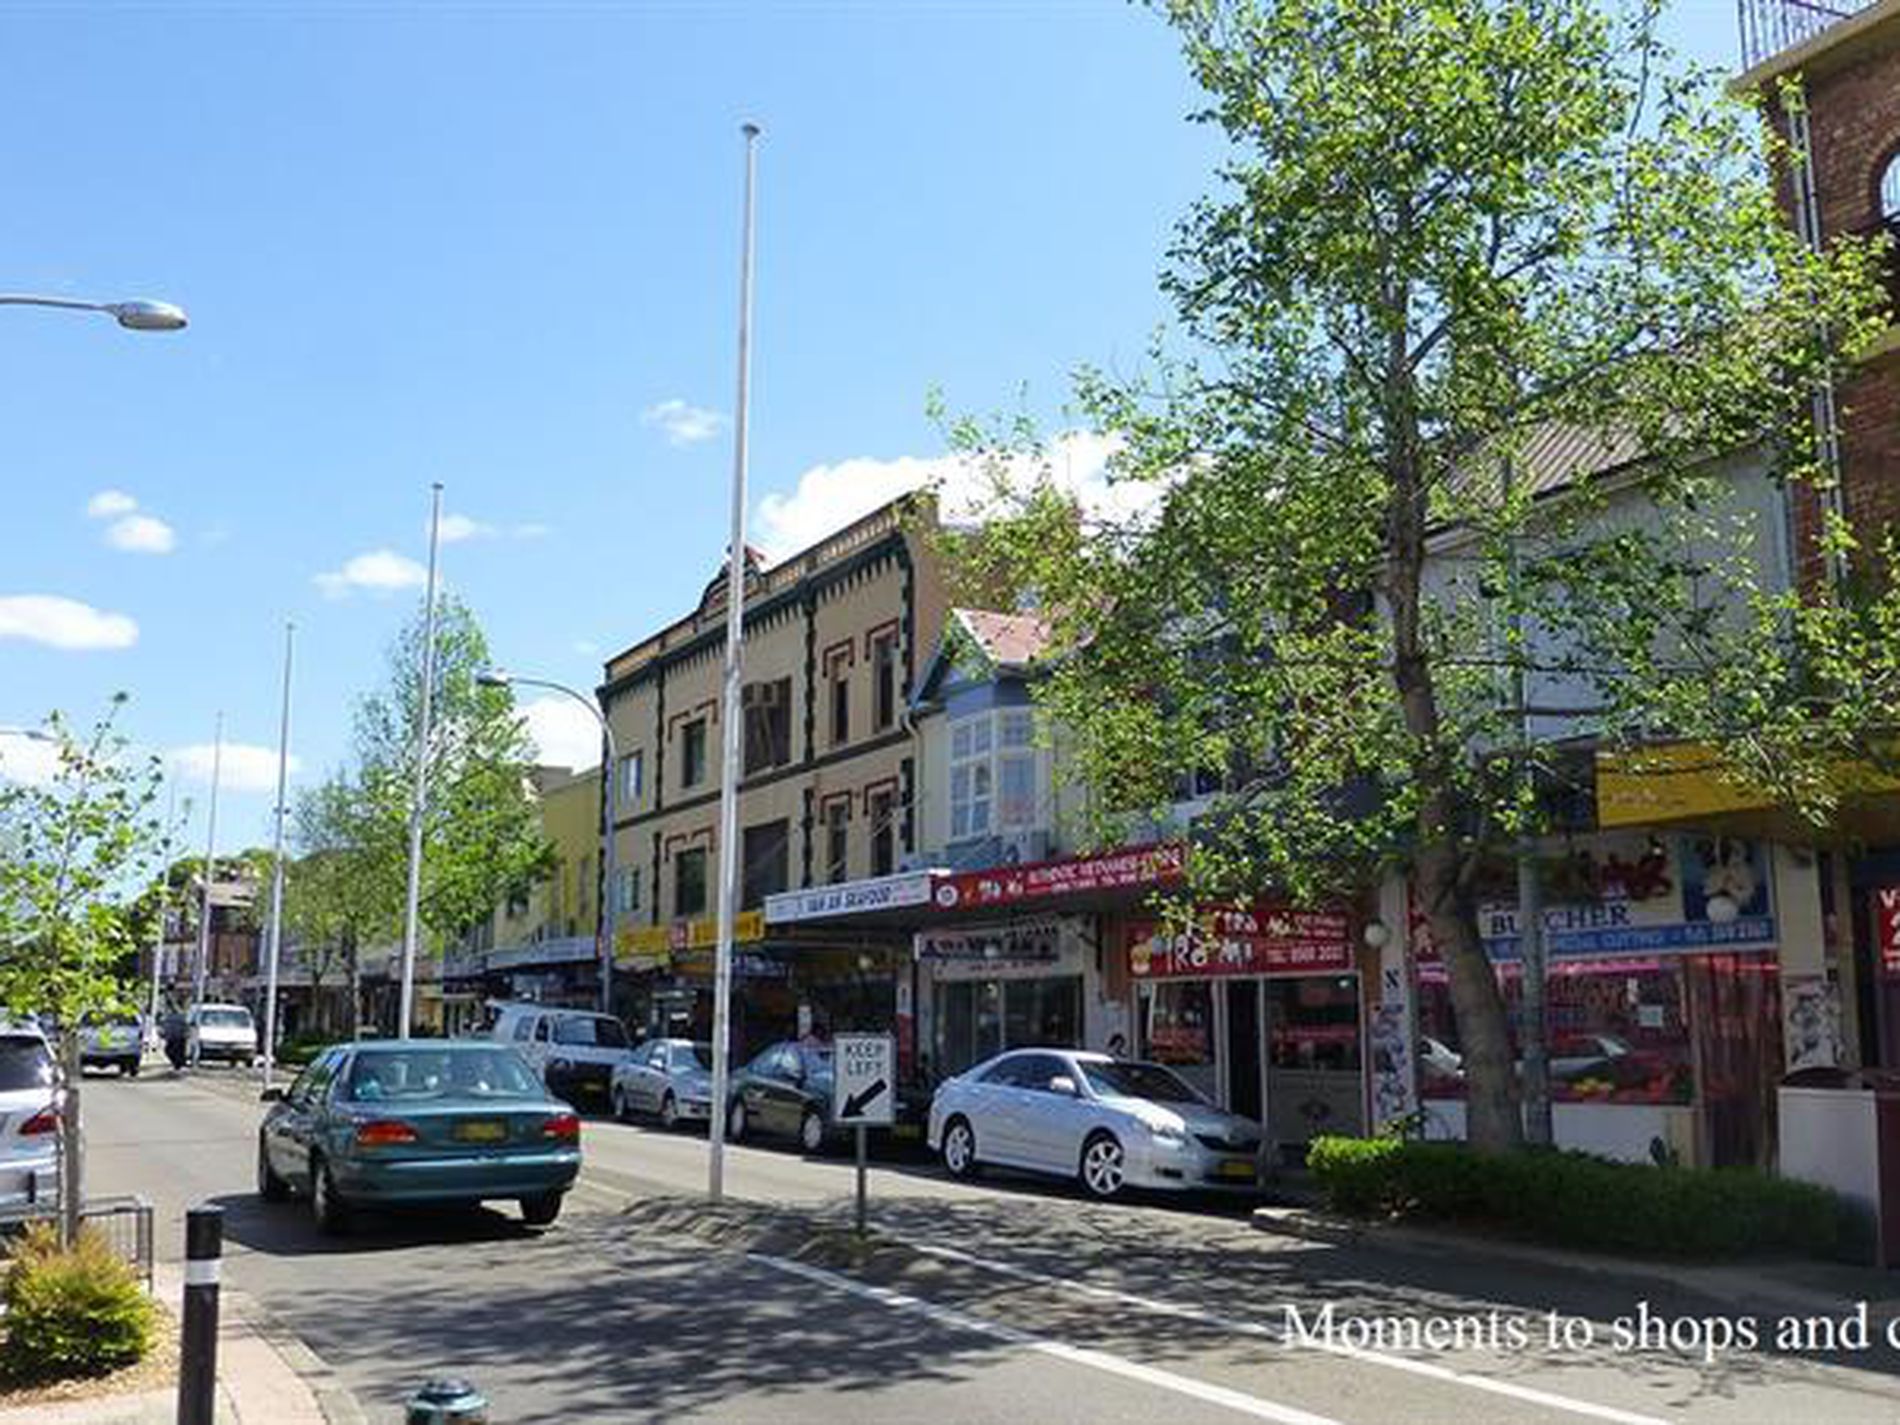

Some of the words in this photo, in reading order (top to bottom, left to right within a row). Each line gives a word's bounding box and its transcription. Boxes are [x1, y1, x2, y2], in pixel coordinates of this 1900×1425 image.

[1490, 902, 1632, 934] BUCHER
[846, 1042, 884, 1059] KEEP
[848, 1061, 885, 1077] LEFT
